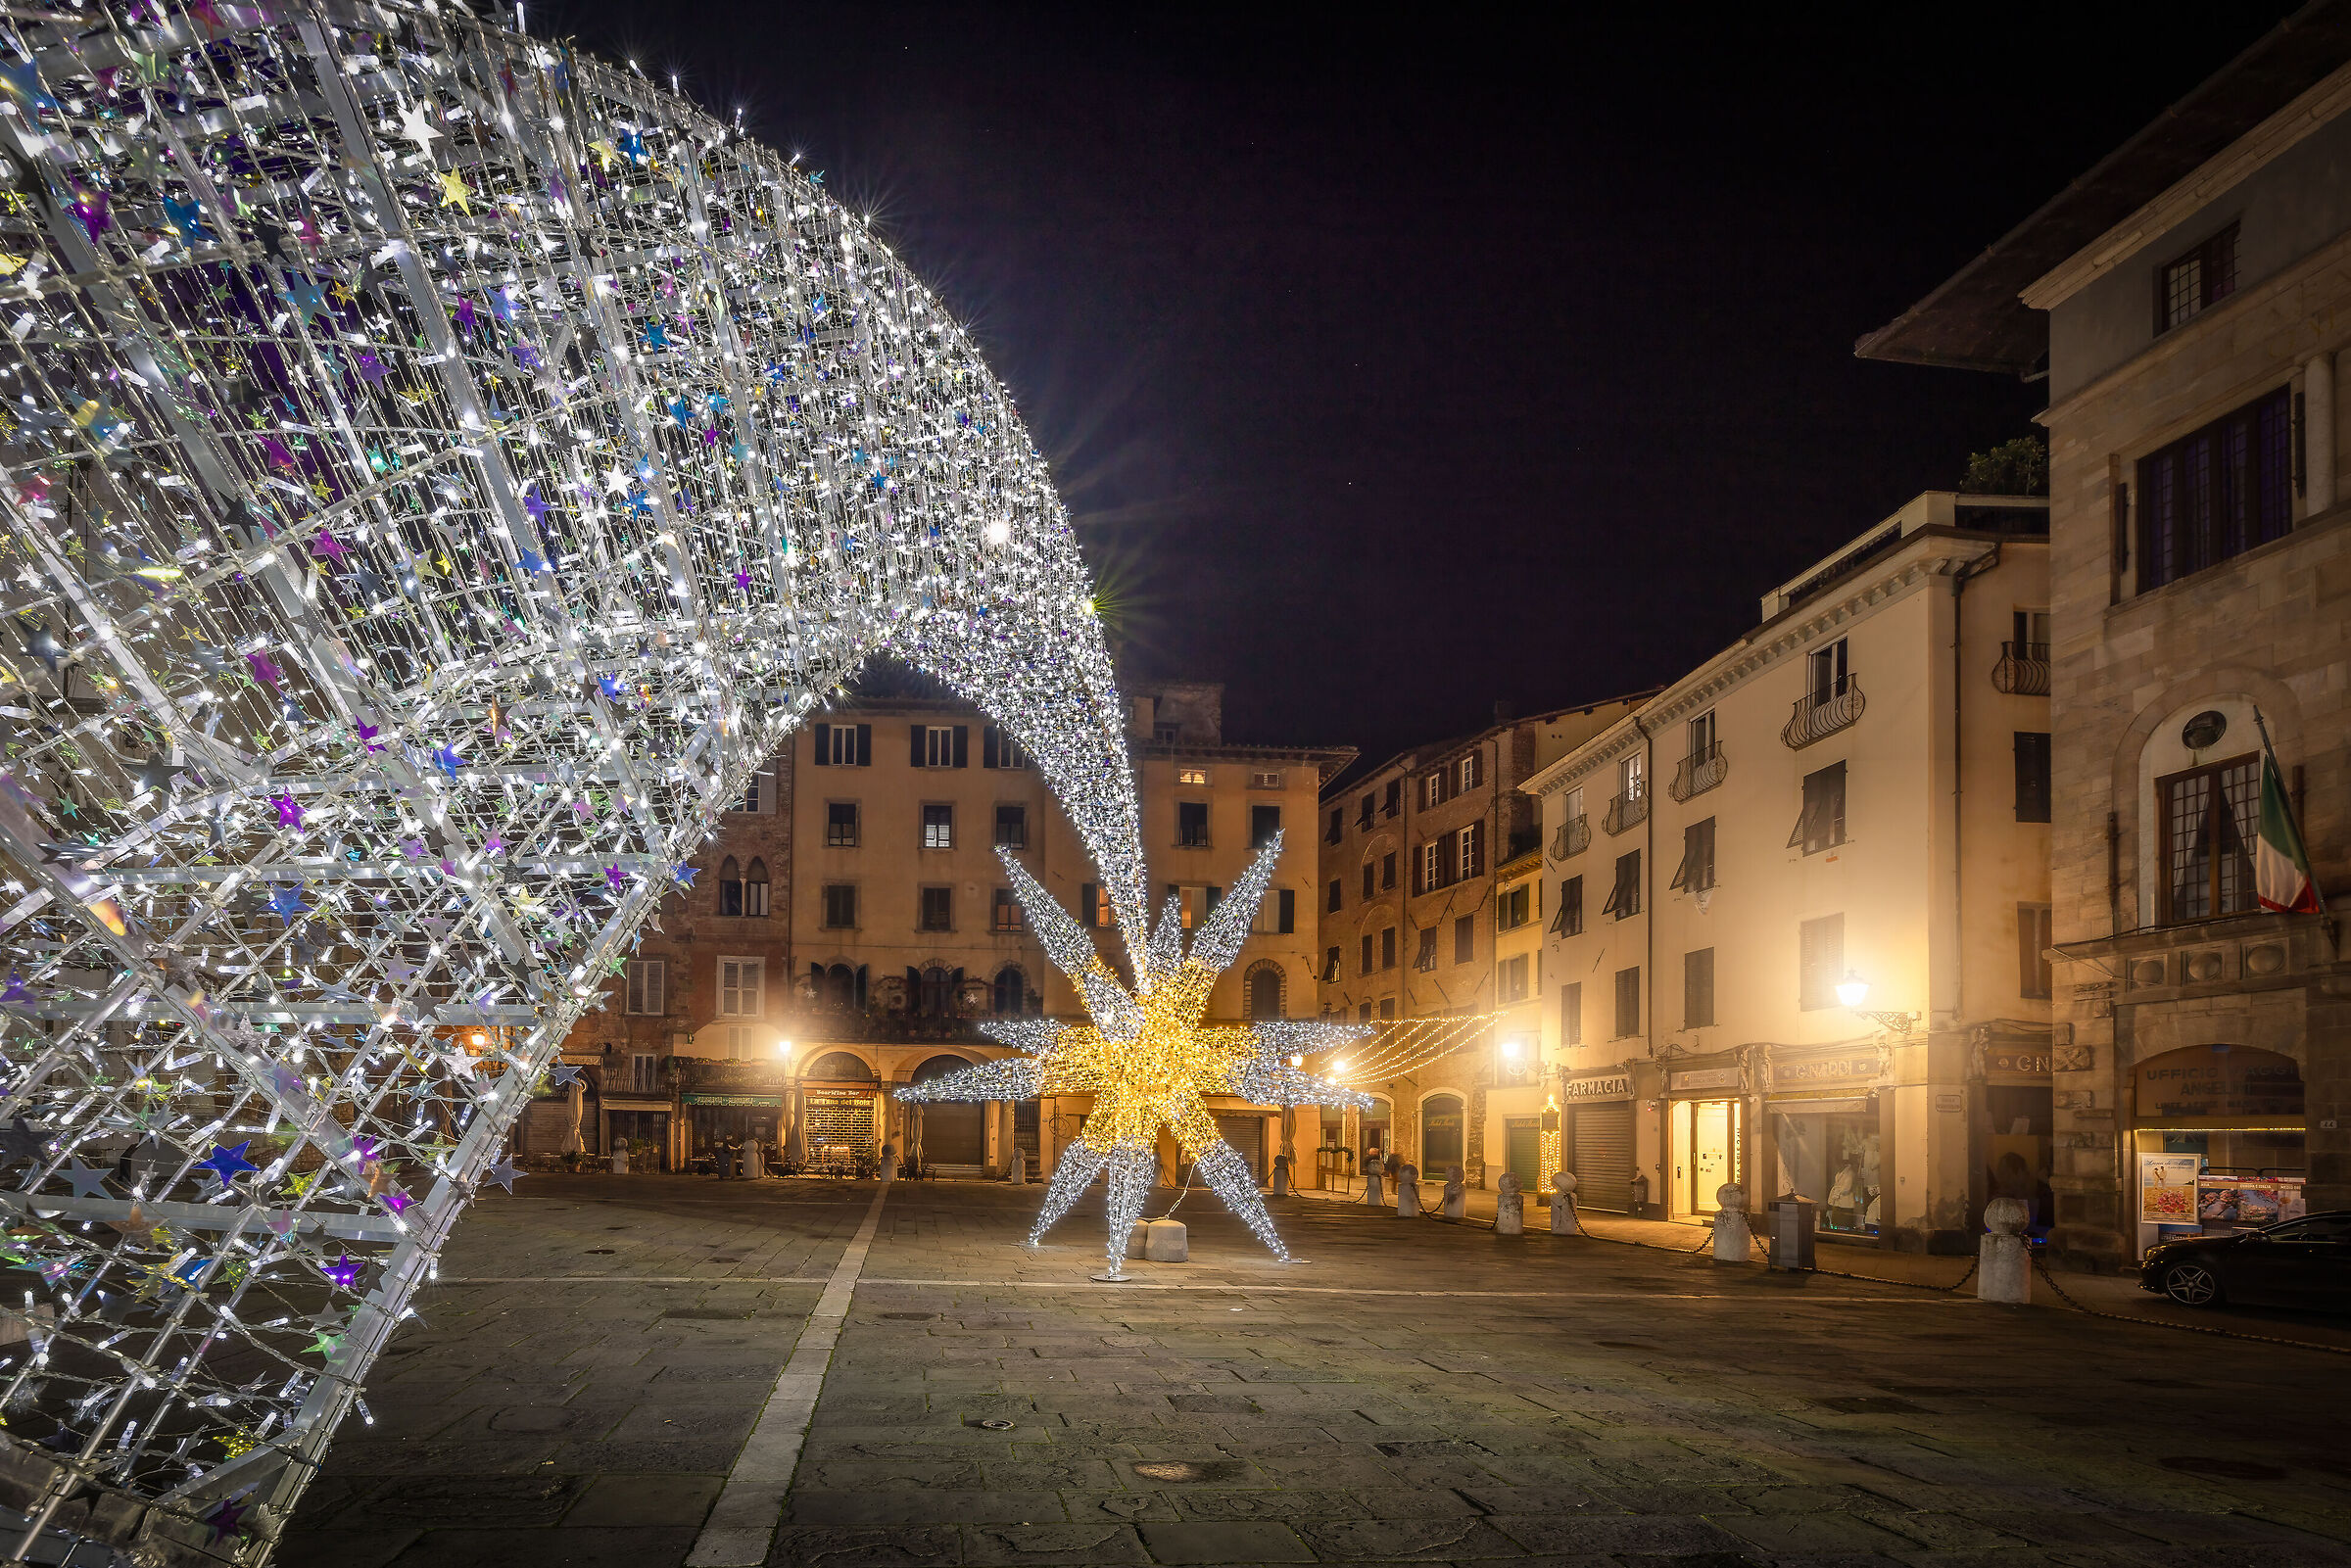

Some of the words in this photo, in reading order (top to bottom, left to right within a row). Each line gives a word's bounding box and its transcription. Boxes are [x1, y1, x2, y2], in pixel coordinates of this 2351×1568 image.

[2146, 1067, 2219, 1080] UFFICIO
[2230, 1065, 2294, 1077] VAGGI
[1566, 1079, 1625, 1096] FARMACIA
